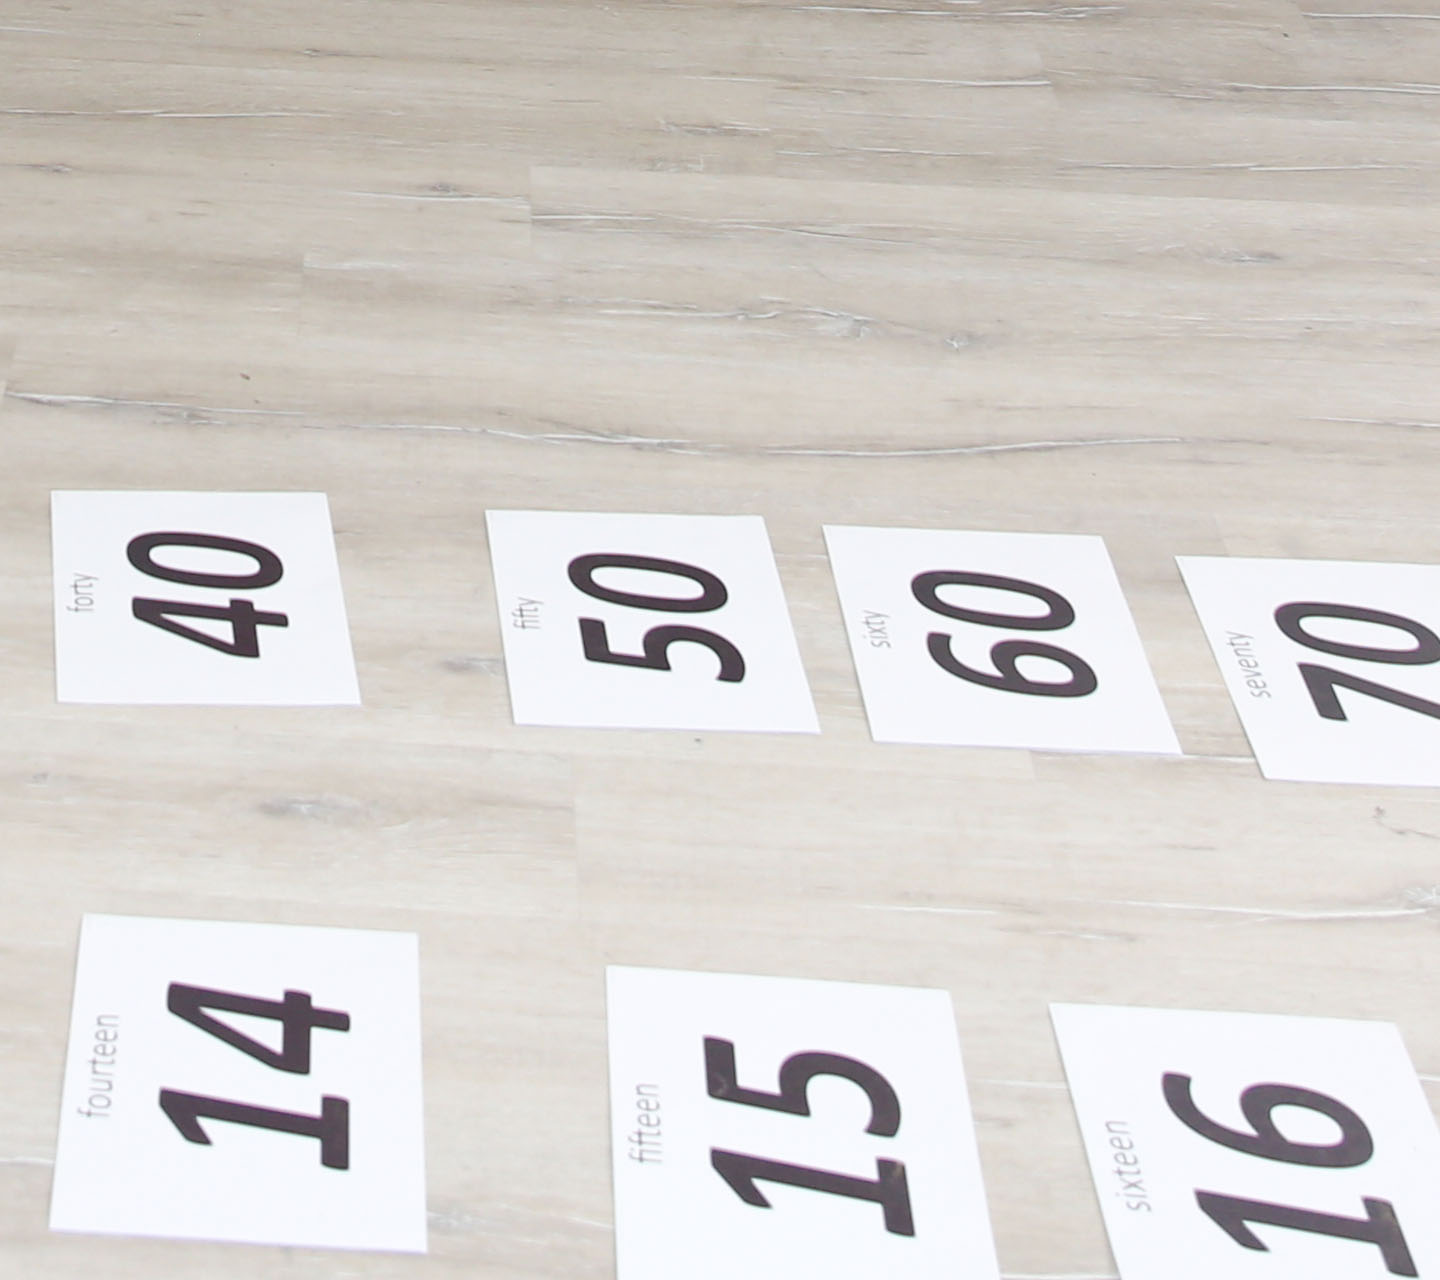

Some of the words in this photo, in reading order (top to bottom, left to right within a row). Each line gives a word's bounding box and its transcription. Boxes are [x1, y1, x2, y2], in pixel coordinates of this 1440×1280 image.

[65, 571, 100, 613] forty
[126, 530, 289, 659] 40
[511, 596, 545, 630] fifty
[567, 552, 746, 683] 50
[869, 609, 891, 650] sixty
[910, 569, 1098, 699] 60
[1224, 629, 1271, 700] seventy
[76, 1013, 119, 1120] fourteen
[159, 981, 351, 1172] 14
[628, 1082, 661, 1166] fifteen
[702, 1034, 917, 1238] 15
[1105, 1119, 1152, 1213] sixteen
[1161, 1071, 1419, 1278] 16
